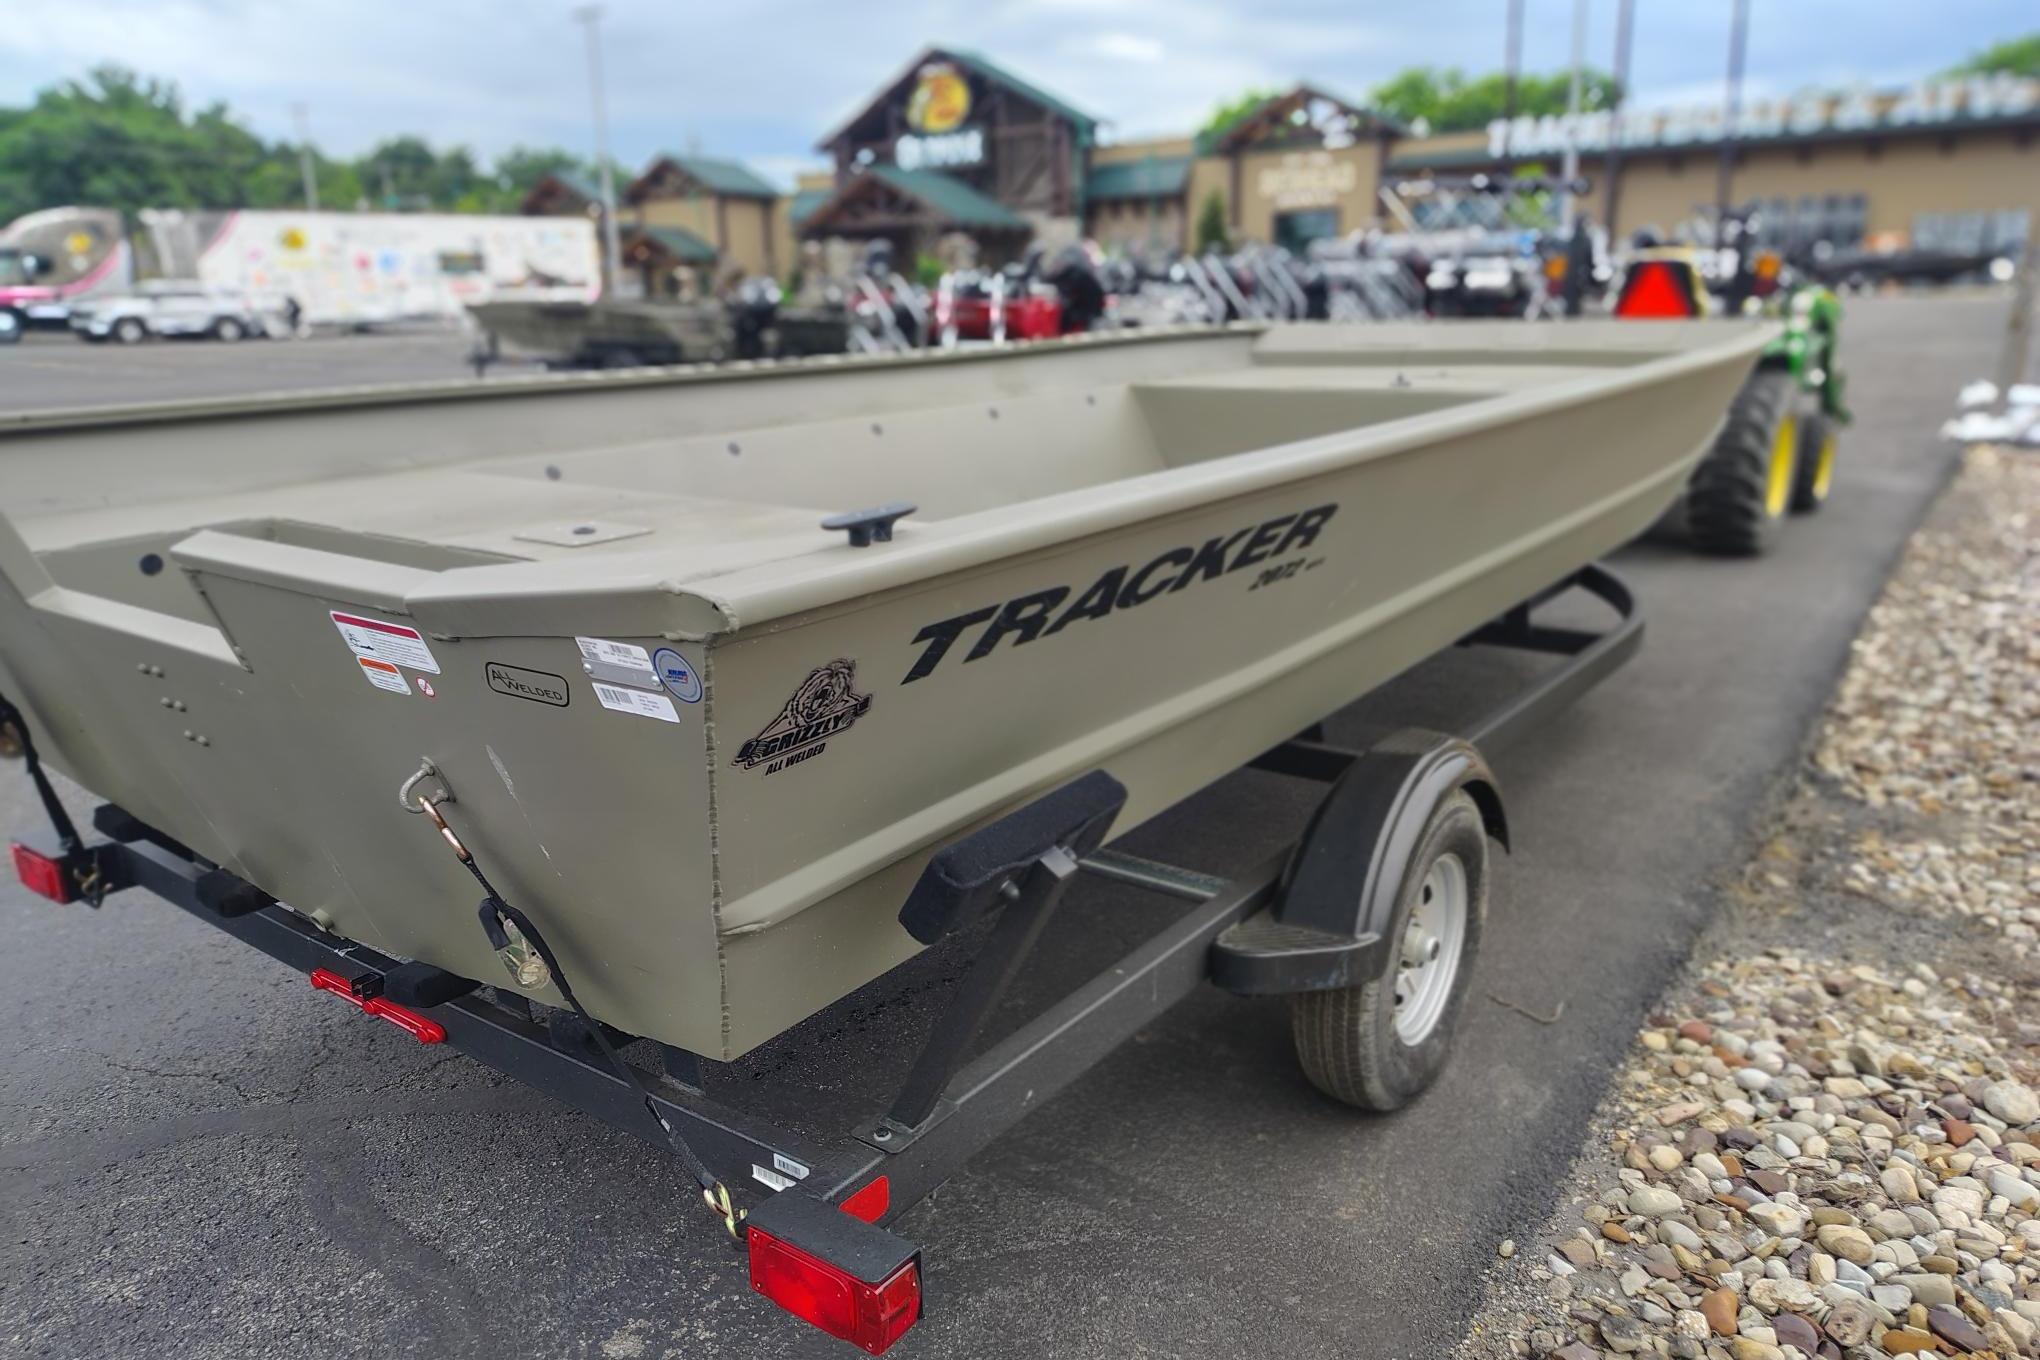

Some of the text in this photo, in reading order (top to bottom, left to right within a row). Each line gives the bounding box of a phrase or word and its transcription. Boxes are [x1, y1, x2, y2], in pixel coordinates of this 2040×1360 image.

[901, 503, 1339, 686] TRACKER
[492, 669, 515, 681] ALL
[498, 679, 563, 701] WELDED
[762, 713, 844, 757] GRIZZLY
[765, 742, 826, 776] ALL WELDED
